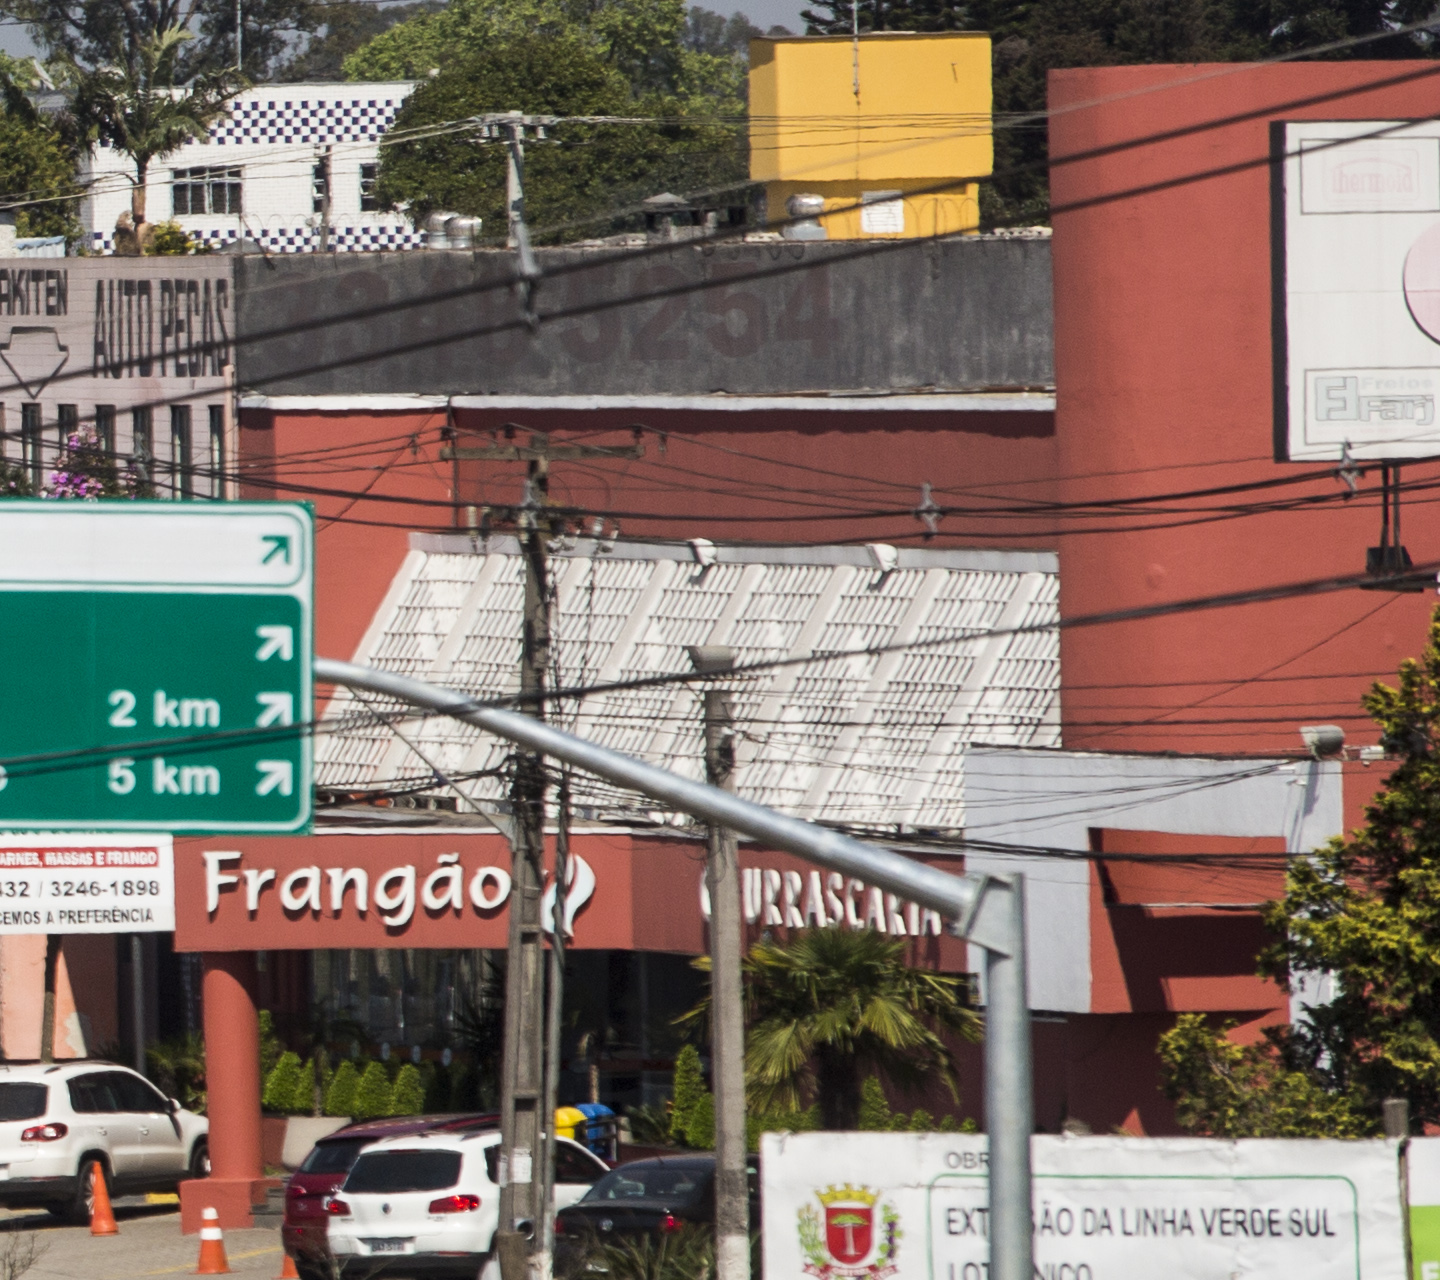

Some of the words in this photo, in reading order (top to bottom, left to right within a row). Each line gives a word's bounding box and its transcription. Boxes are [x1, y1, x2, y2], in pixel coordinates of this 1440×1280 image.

[93, 278, 153, 379] AUTO
[107, 689, 139, 728] 2
[152, 690, 221, 728] km
[107, 757, 138, 795] 5
[152, 759, 221, 795] km
[44, 851, 94, 866] MASSAS
[95, 851, 105, 866] E
[106, 850, 158, 865] FRANGO
[50, 879, 161, 897] 3246-1898
[202, 850, 512, 927] Frangão
[700, 867, 943, 936] CURRASCARIA
[46, 909, 56, 924] A
[59, 906, 155, 924] PREFERÊNCIA
[946, 1150, 991, 1170] OBR
[946, 1200, 1074, 1236] EXTÃO
[1082, 1207, 1114, 1237] DA
[1120, 1207, 1195, 1237] LINHA
[1199, 1207, 1281, 1238] VERDE
[1288, 1209, 1336, 1237] SUL
